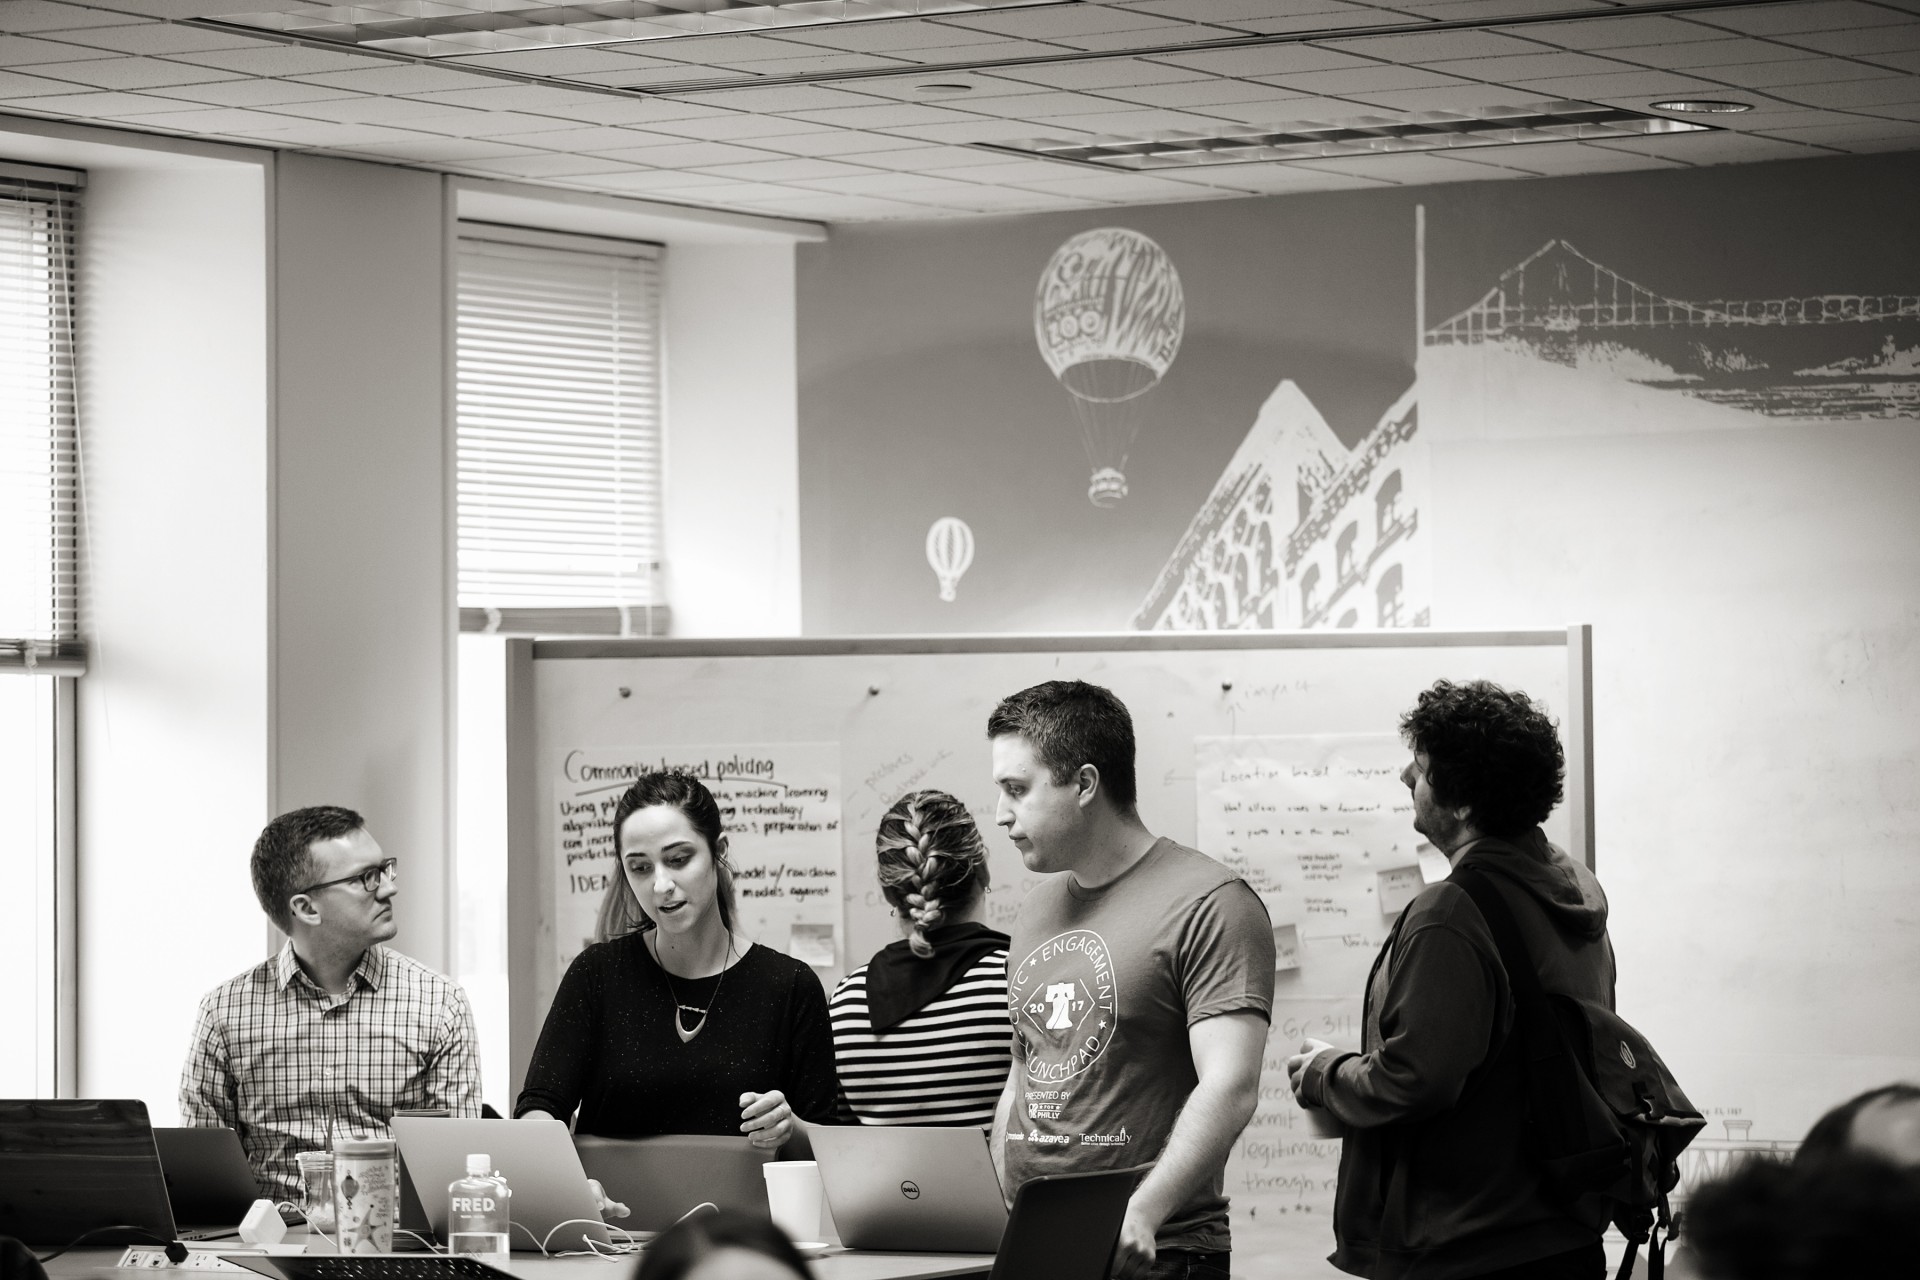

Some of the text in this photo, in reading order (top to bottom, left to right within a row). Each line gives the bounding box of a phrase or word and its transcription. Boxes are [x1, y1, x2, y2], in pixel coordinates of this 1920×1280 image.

[1009, 936, 1113, 1025] CIVIC ENGAGEMENT
[1029, 1000, 1085, 1014] 20 17
[1024, 1090, 1071, 1101] PRESENTED BY
[1037, 1111, 1061, 1119] PHILLY
[1038, 1135, 1070, 1144] azavea
[452, 1197, 496, 1212] FRED
